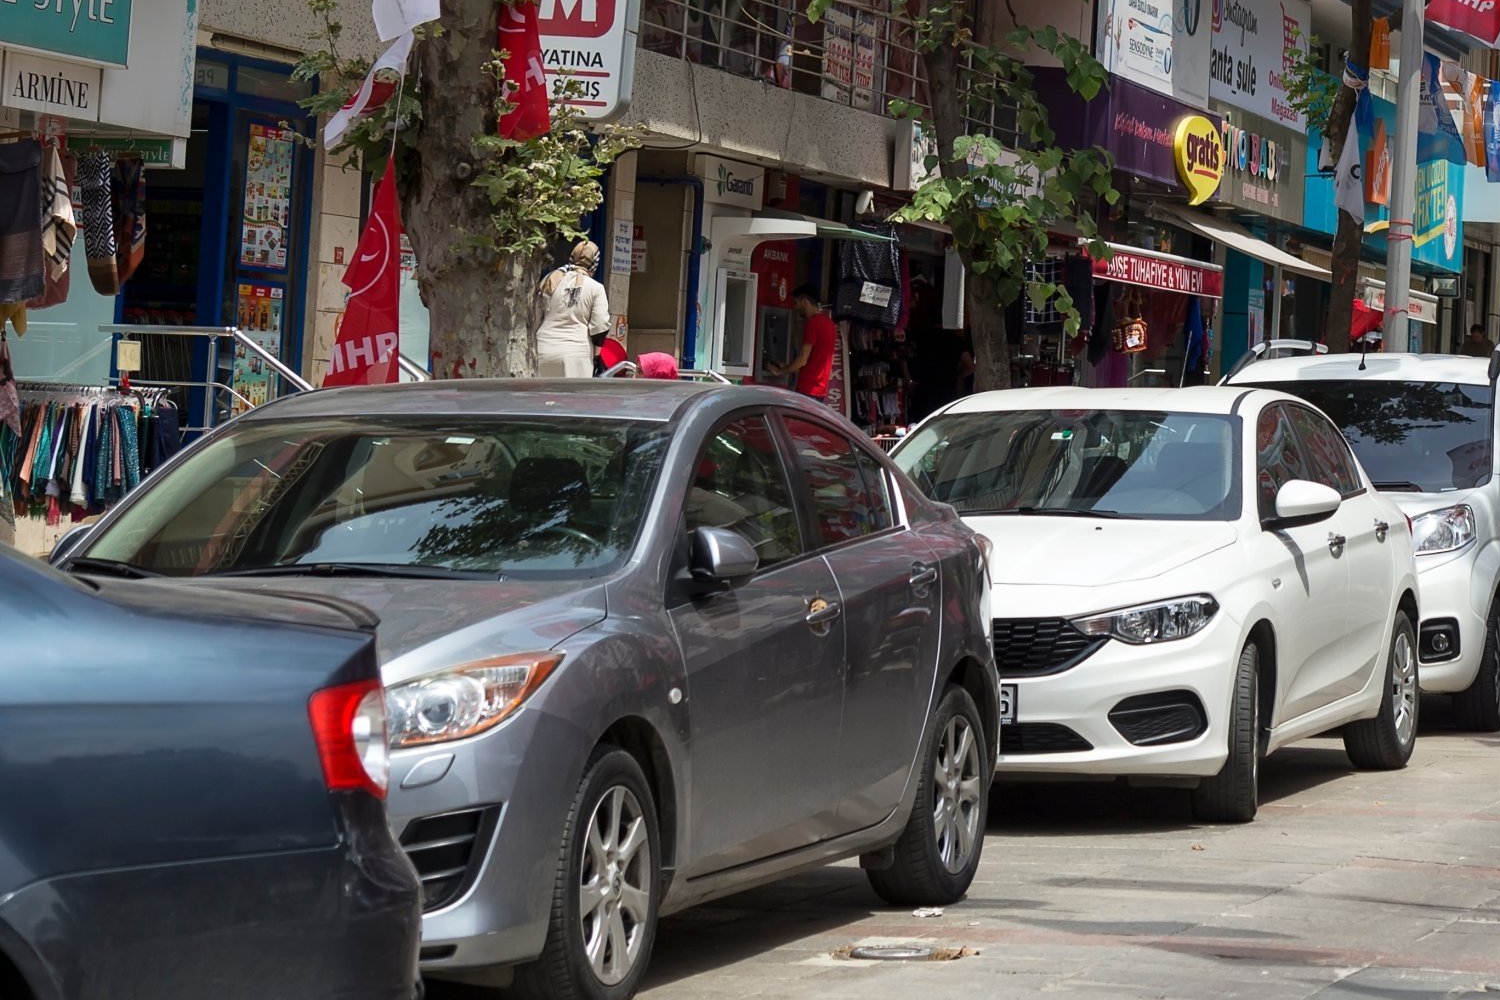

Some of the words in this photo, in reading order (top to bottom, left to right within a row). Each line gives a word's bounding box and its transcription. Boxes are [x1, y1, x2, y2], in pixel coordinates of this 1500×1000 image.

[540, 48, 604, 69] YATINA
[1210, 44, 1257, 96] anta_sule
[12, 69, 89, 110] ARMİNE
[1186, 130, 1219, 172] gratis
[726, 172, 754, 197] Garanti
[763, 248, 789, 263] AKBANK
[1130, 259, 1167, 286] TUHAFİYE
[1168, 267, 1174, 287] &
[1175, 264, 1190, 291] YÜN
